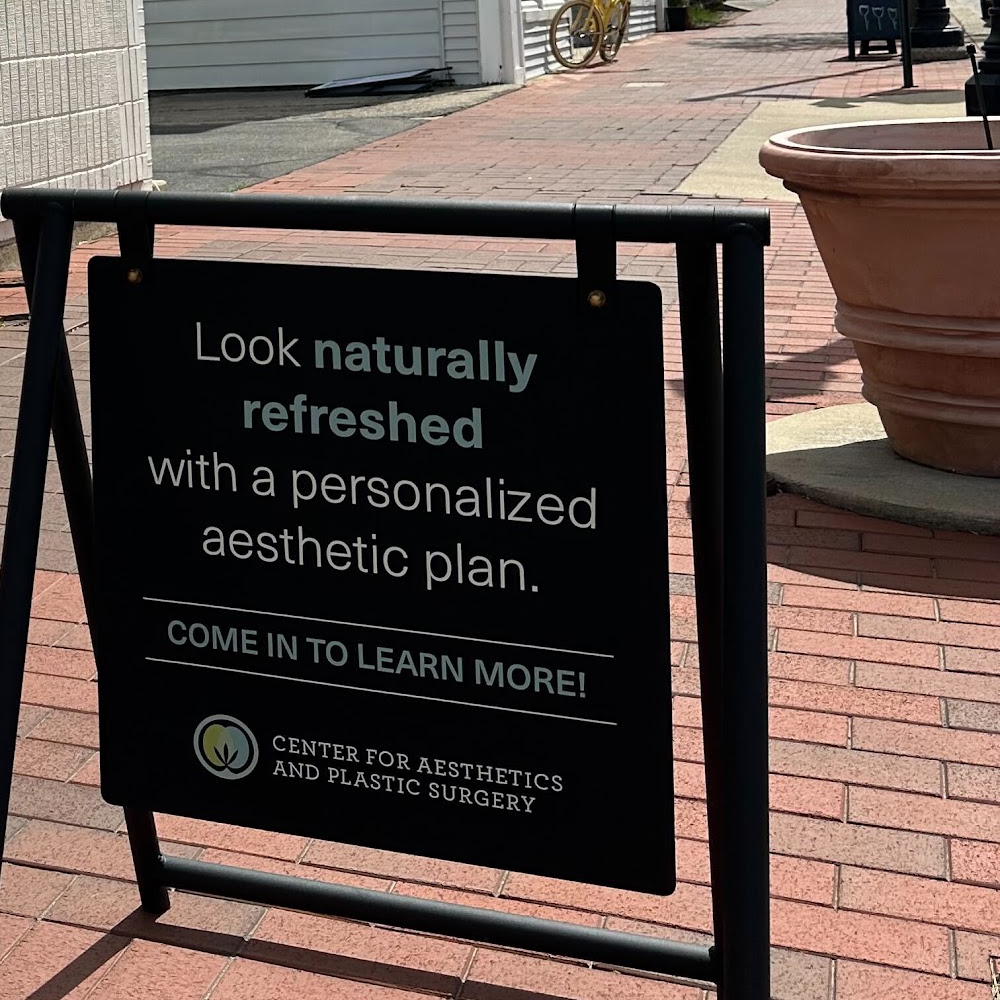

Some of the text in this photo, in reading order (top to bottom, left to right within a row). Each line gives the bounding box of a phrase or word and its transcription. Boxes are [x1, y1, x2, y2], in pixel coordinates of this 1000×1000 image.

[196, 322, 537, 392] Look naturally
[244, 394, 482, 448] refreshed
[148, 449, 596, 529] with a personalized
[203, 526, 538, 592] aesthetic plan.
[168, 620, 585, 697] COME IN TO LEARN MORE!
[273, 735, 562, 791] CENTER FOR AESTHETICS
[273, 760, 535, 813] AND PLASTIC SURGERY
